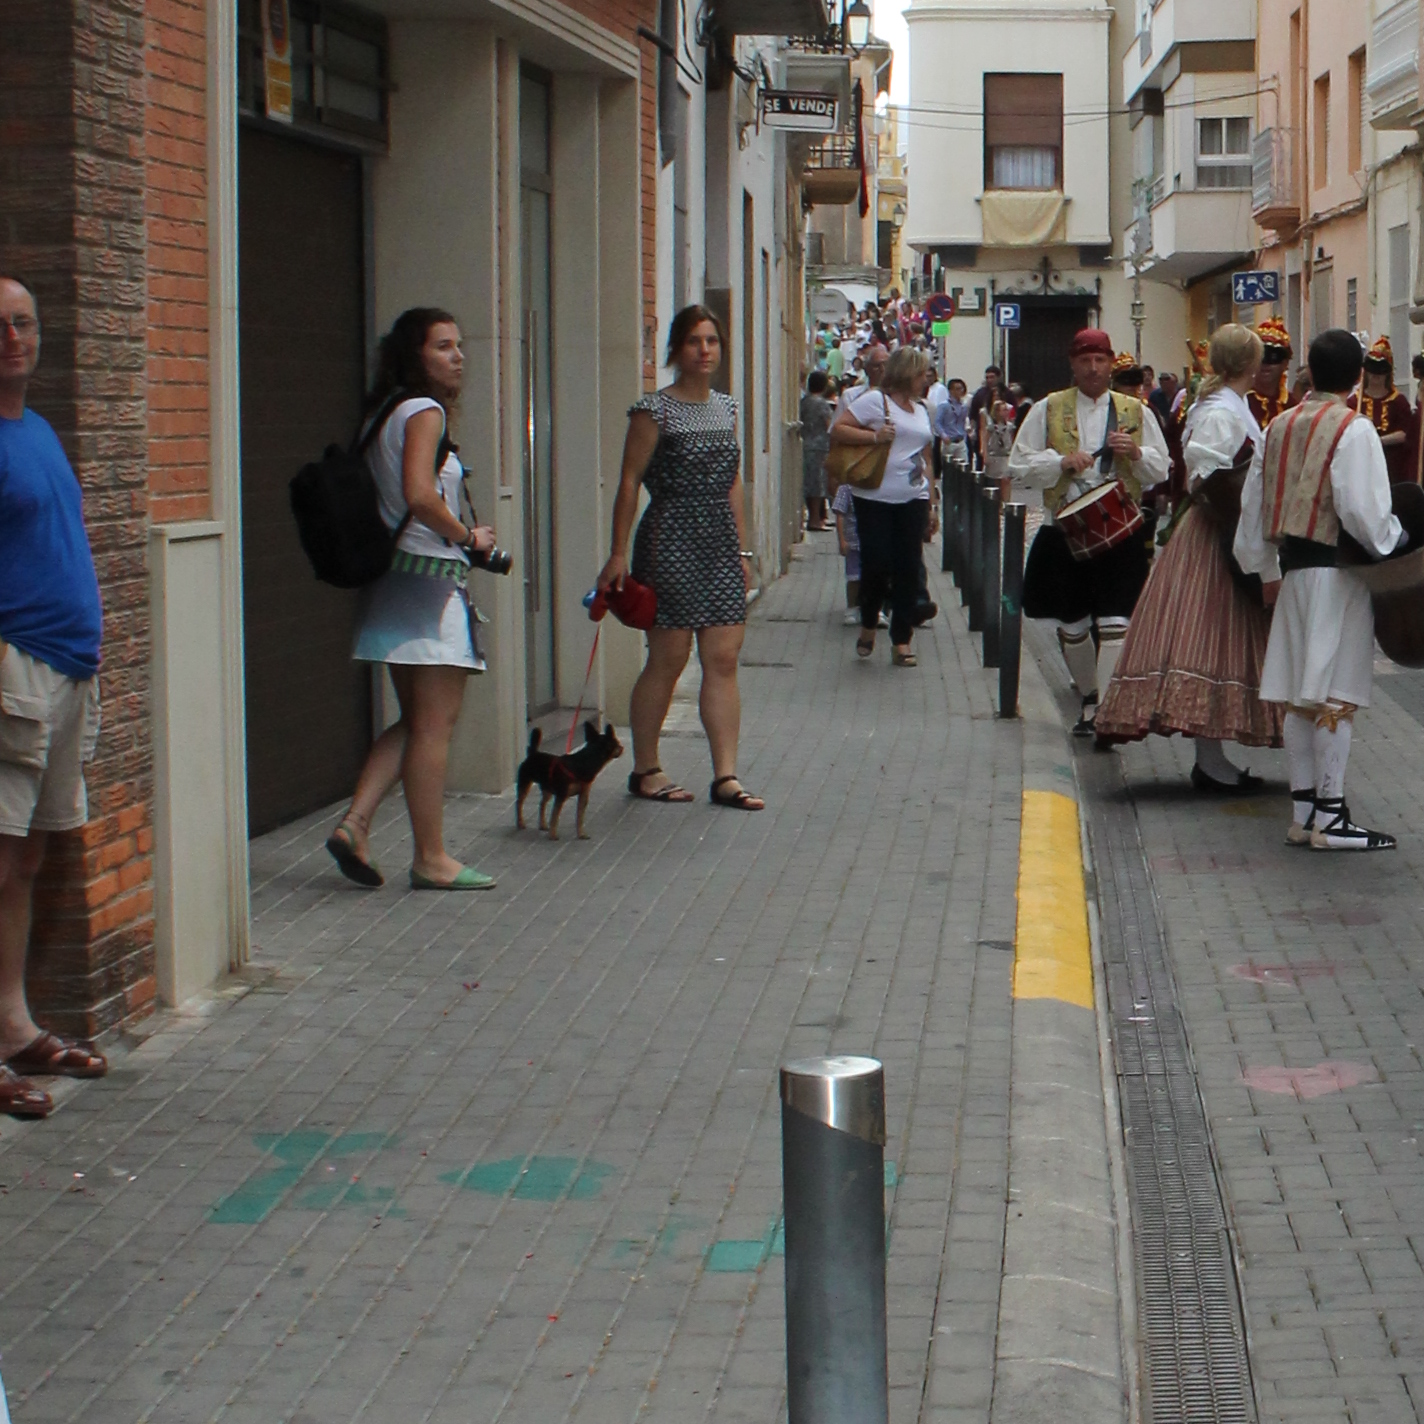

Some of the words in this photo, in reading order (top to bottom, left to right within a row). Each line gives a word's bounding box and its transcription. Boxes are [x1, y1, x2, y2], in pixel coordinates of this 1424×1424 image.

[764, 98, 780, 113] SE
[789, 98, 834, 116] VENDE
[999, 306, 1015, 326] P
